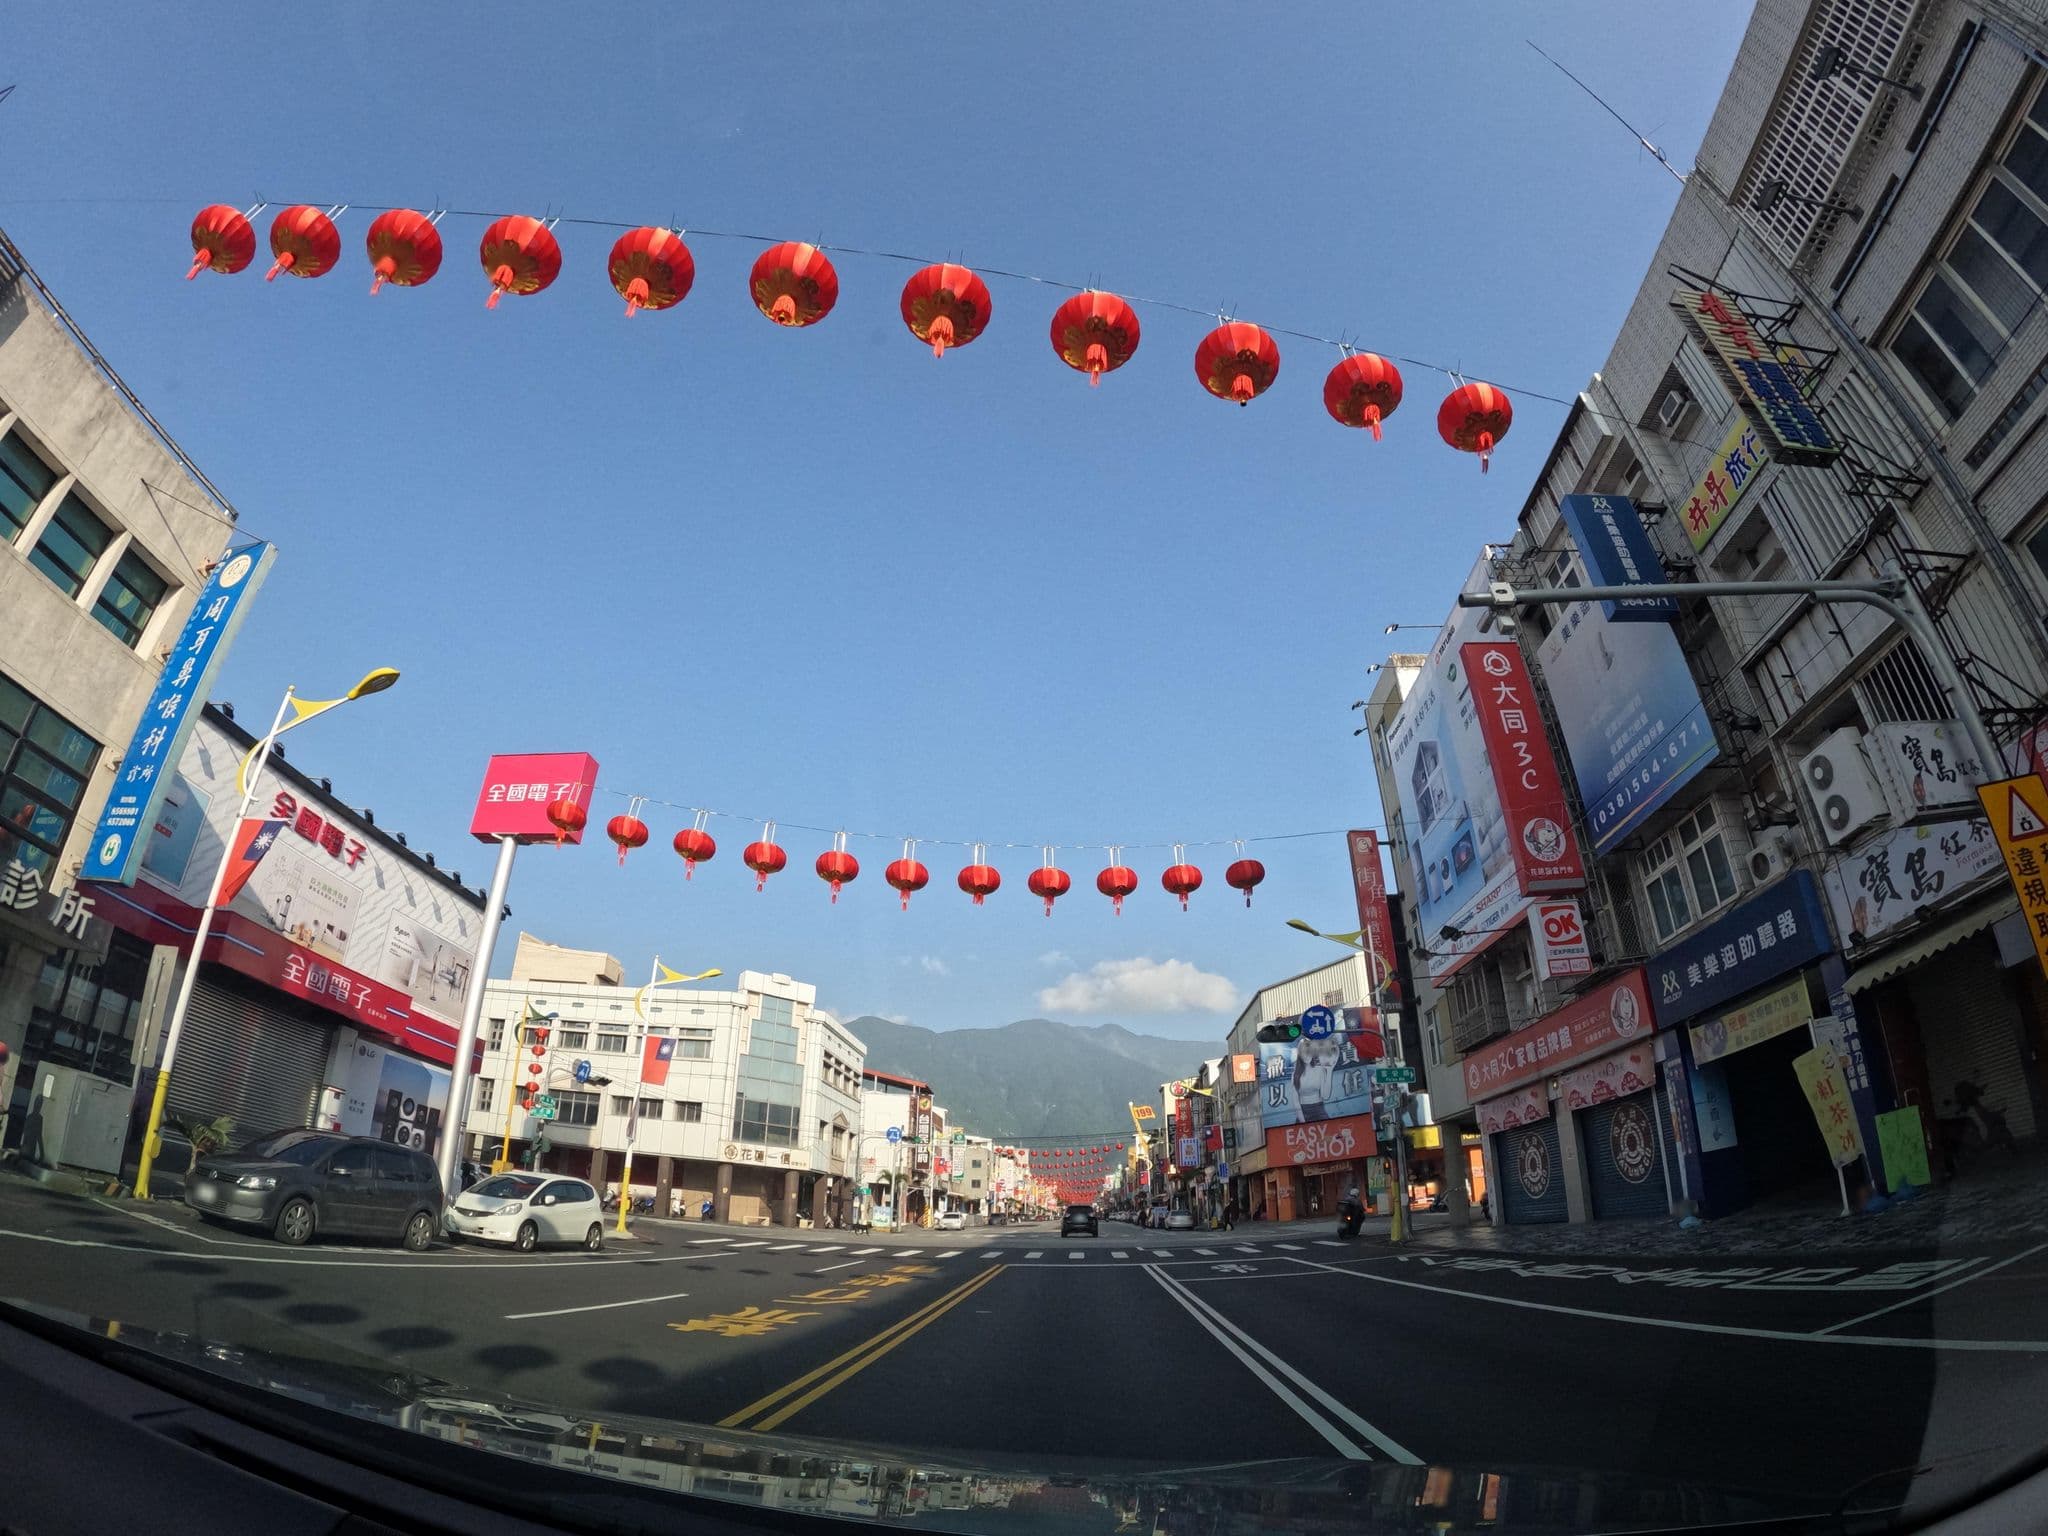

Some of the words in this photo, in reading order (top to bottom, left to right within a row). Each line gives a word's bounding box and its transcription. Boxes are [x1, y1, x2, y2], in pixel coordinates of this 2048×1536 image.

[141, 595, 230, 757] 周耳鼻喉科
[1492, 681, 1540, 791] 大同3C
[486, 783, 571, 802] 全國電子
[1593, 720, 1701, 833] (038)564-671
[270, 791, 367, 867] 全國電子
[0, 859, 96, 940] 診所
[1544, 913, 1580, 938] OK
[282, 953, 373, 1010] 全國電子
[1687, 909, 1798, 988] 美樂迪助聽器
[1135, 1107, 1153, 1118] 199
[1285, 1124, 1328, 1146] EASY
[1305, 1136, 1356, 1160] SHOP
